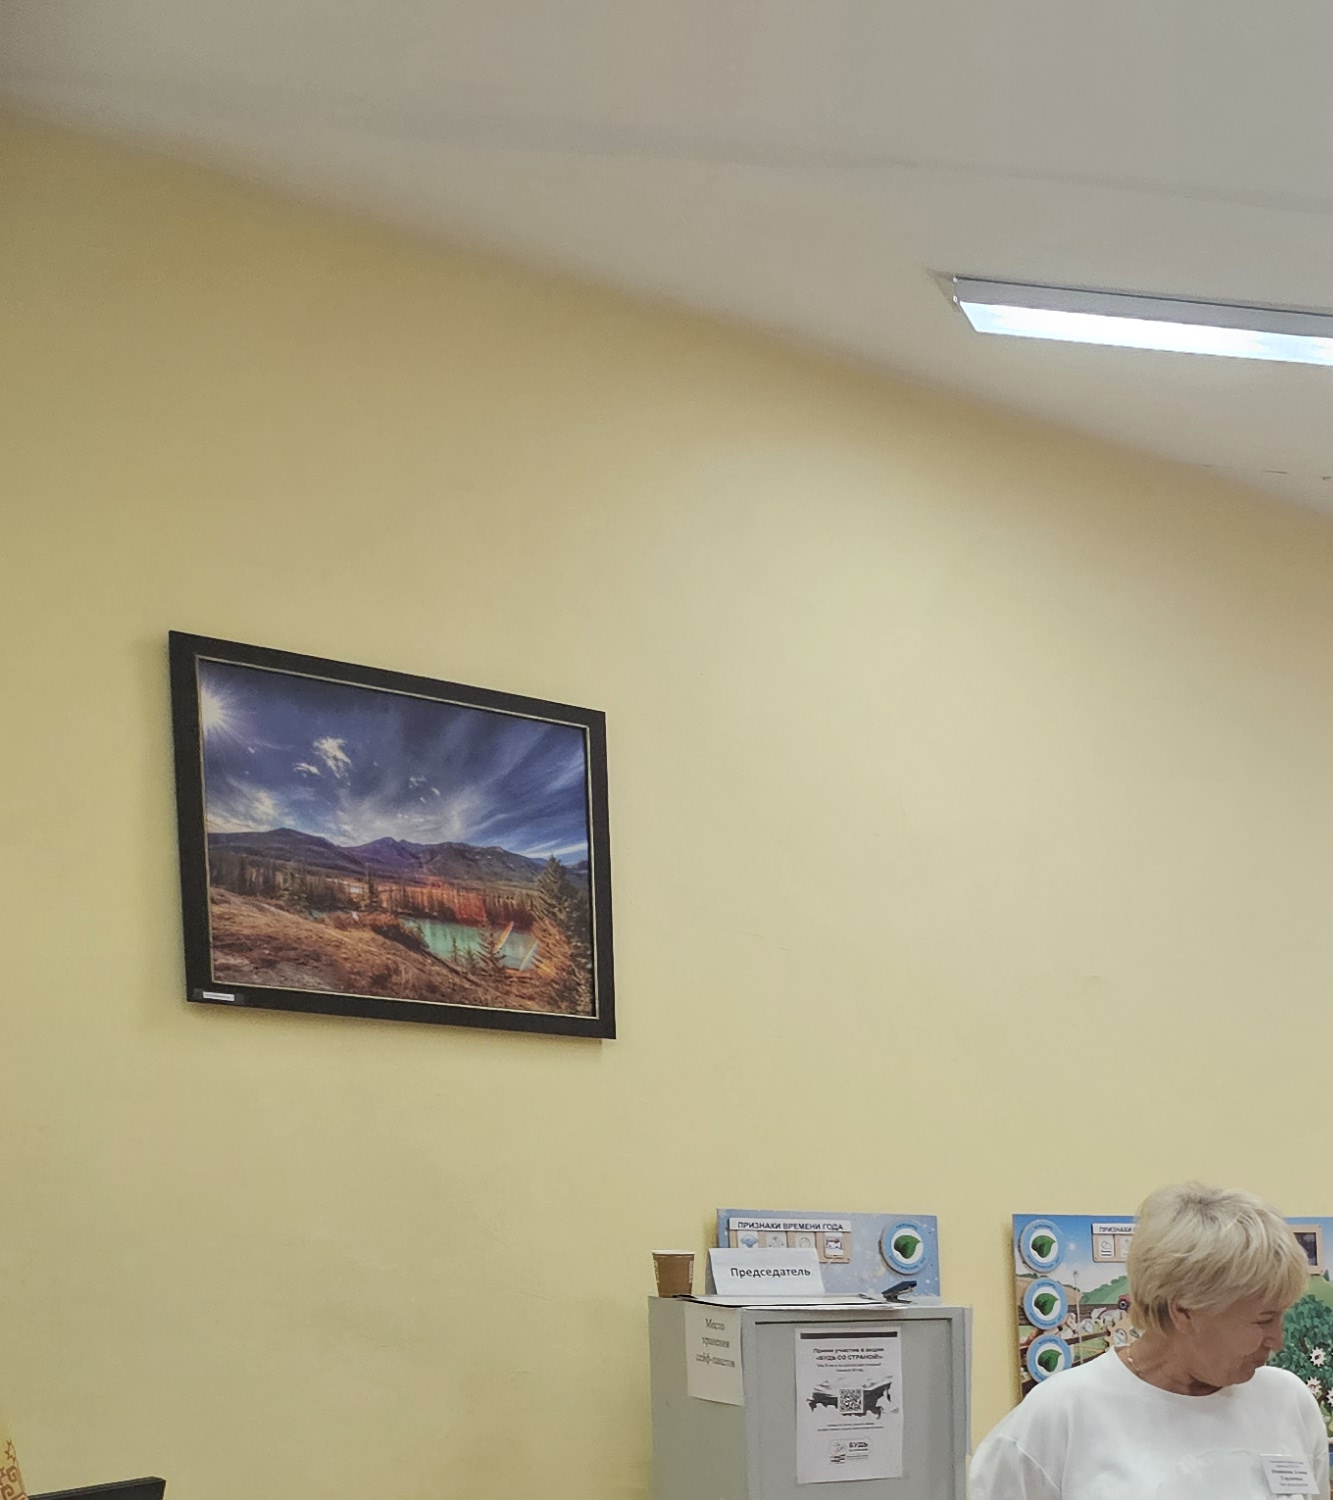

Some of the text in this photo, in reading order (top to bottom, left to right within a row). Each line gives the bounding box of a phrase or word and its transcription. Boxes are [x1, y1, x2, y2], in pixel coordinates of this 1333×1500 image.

[738, 1221, 844, 1231] ПРИЗНАКИ ВРЕМЕНИ ГОДА
[731, 1267, 811, 1278] Председатель
